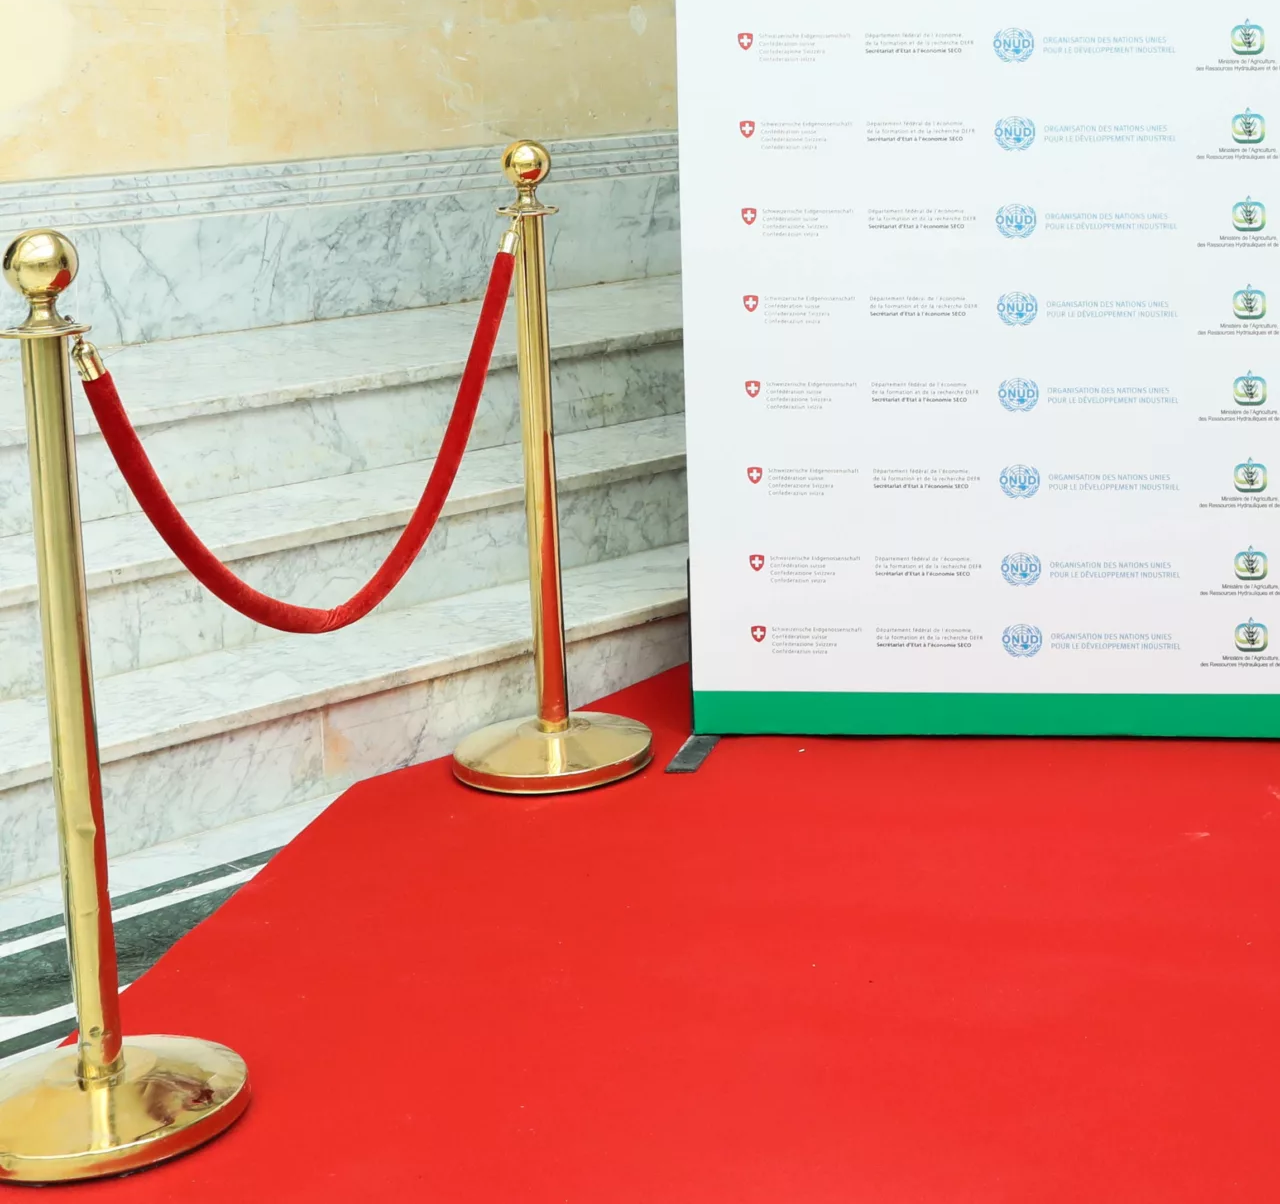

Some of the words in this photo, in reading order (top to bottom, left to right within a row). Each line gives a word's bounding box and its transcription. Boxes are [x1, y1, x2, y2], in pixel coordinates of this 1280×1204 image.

[992, 38, 1035, 48] ONUDI
[994, 126, 1036, 137] ONUDI
[995, 214, 1037, 224] ONUDI
[996, 302, 1038, 312] ONUDI
[997, 388, 1039, 398] ONUDI
[999, 475, 1040, 485] ONUDI
[1000, 562, 1042, 572] ONUDI
[1001, 634, 1043, 644] ONUDI
